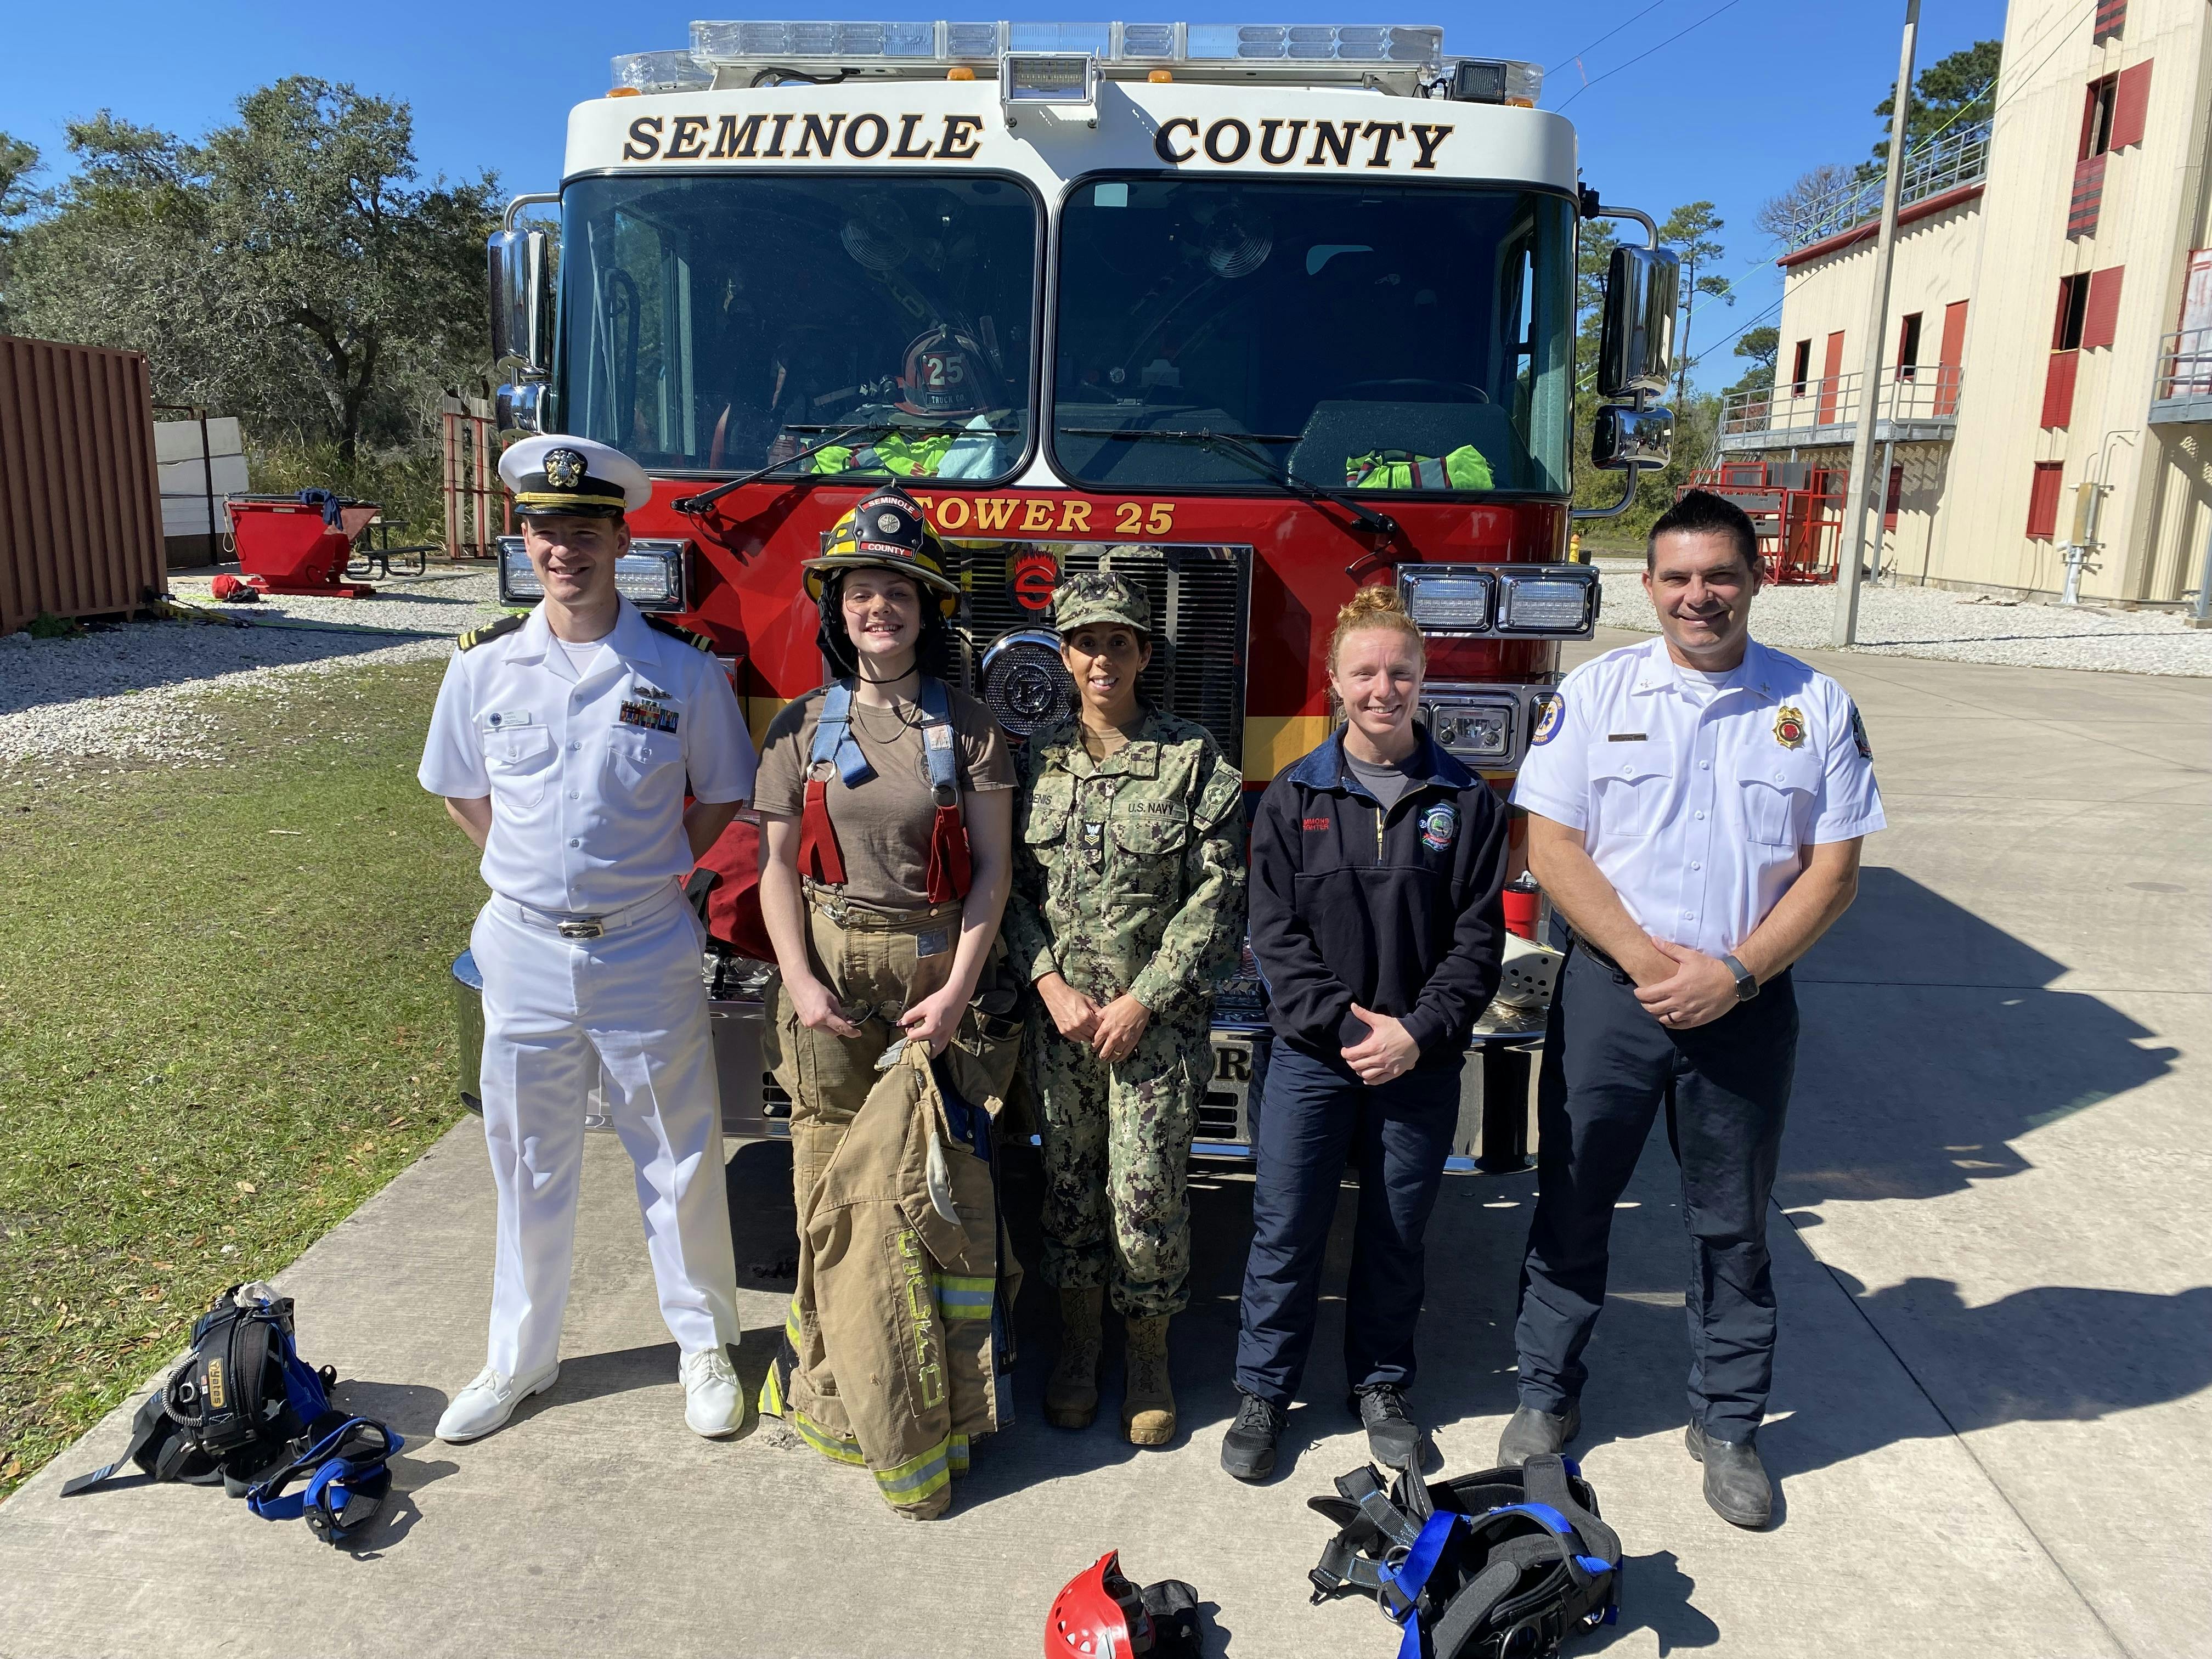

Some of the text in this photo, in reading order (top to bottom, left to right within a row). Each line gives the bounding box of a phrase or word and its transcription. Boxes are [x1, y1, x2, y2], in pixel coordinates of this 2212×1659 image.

[623, 112, 1455, 170] SEMINOLE COUNTY
[928, 357, 963, 385] 25
[931, 396, 953, 404] TRUCK
[868, 496, 915, 514] SEMINOLE
[1115, 501, 1175, 535] 25
[868, 544, 905, 555] COUNTY
[1028, 793, 1052, 805] DENIS
[1128, 803, 1174, 815] U.S. NAVY
[1212, 1047, 1253, 1083] R
[898, 1230, 944, 1409] SCFD
